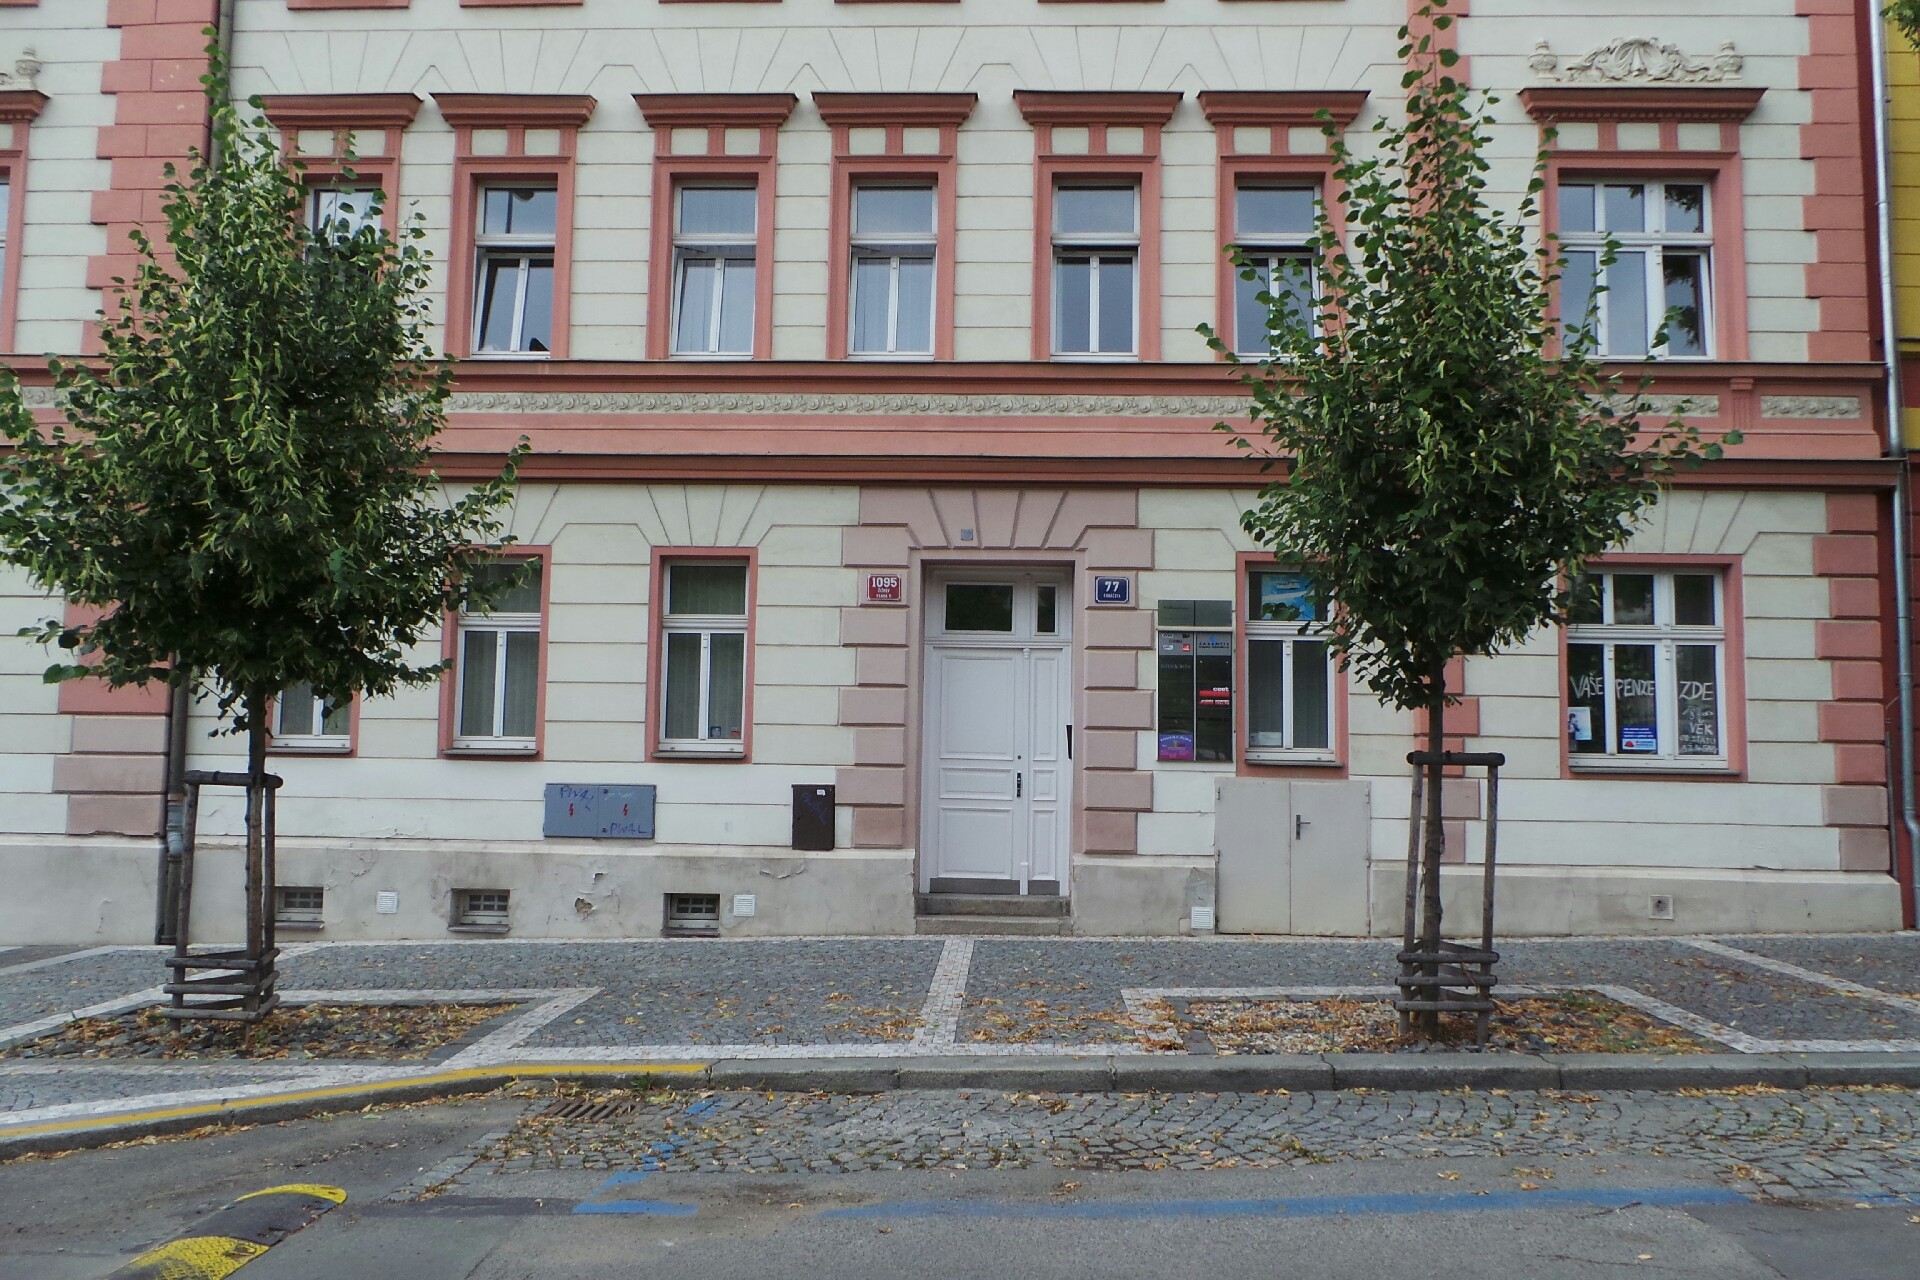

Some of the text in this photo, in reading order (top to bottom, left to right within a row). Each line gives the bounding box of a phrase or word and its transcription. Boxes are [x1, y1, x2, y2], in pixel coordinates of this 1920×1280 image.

[872, 577, 897, 588] 1095
[1105, 582, 1120, 592] 77
[1569, 672, 1604, 699] VAŠE
[1679, 681, 1714, 701] ZDE
